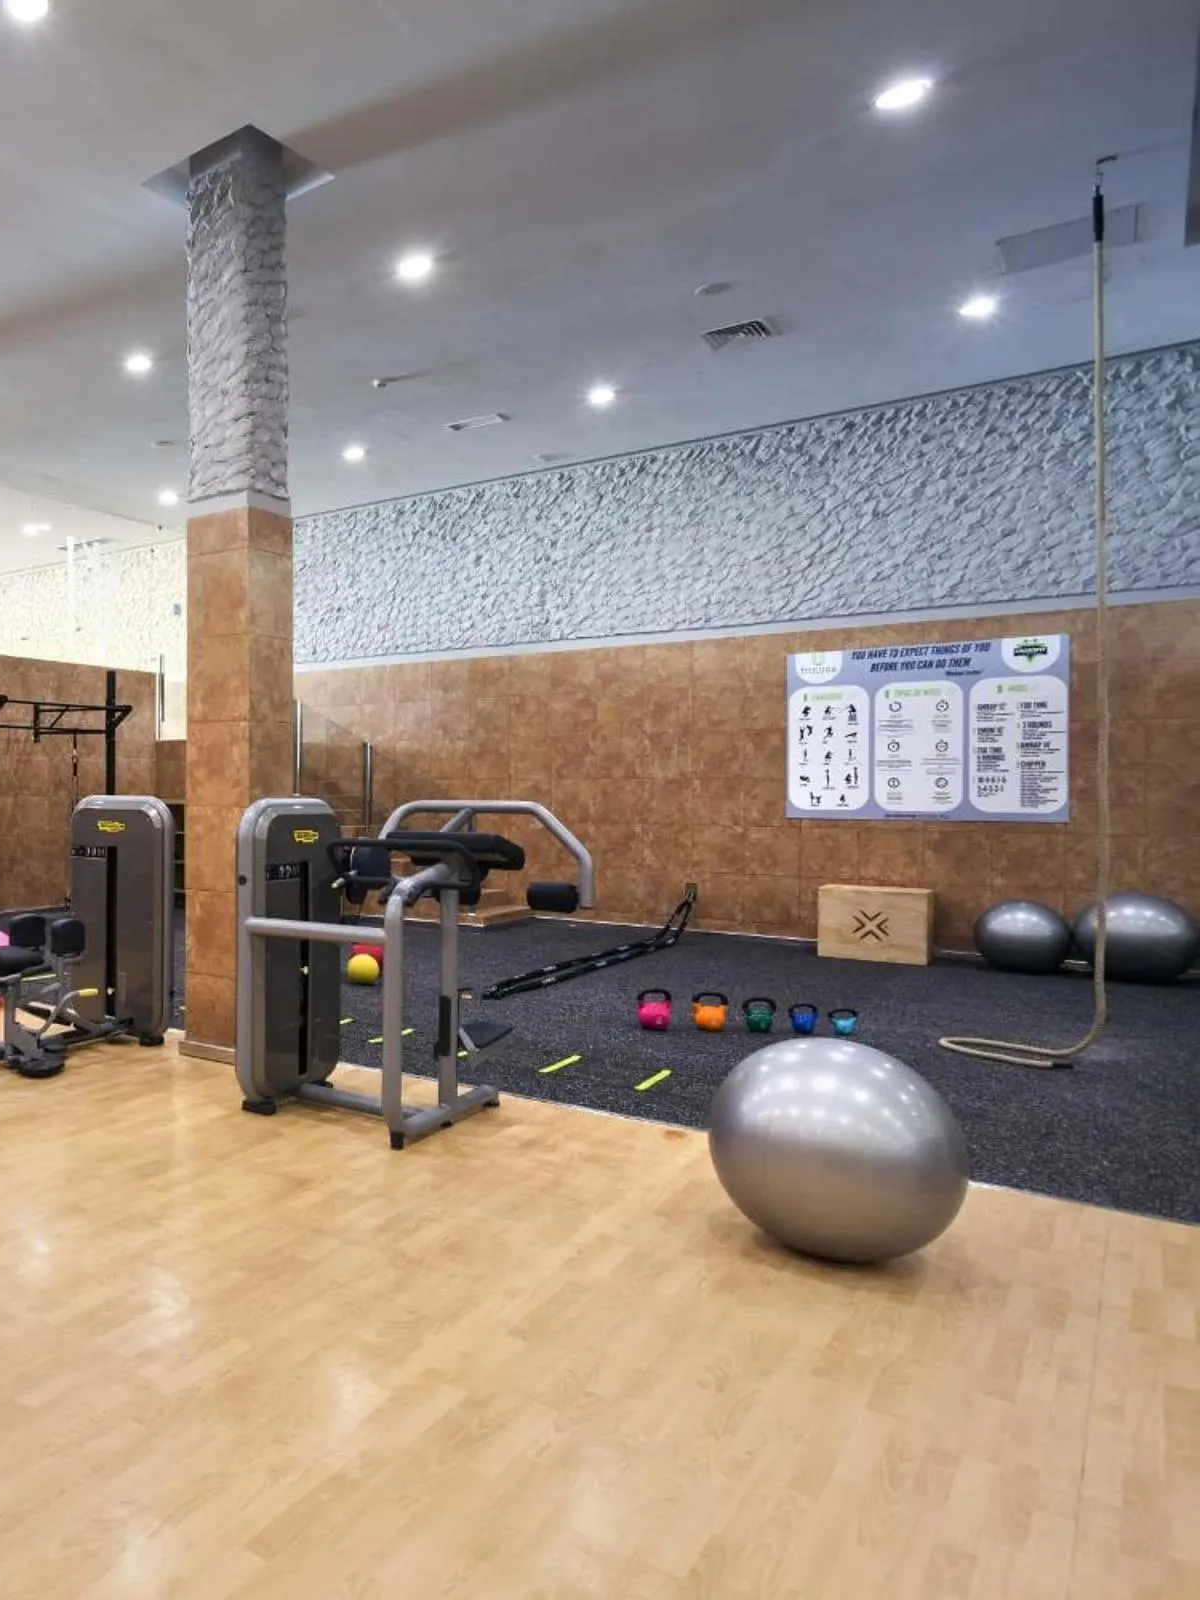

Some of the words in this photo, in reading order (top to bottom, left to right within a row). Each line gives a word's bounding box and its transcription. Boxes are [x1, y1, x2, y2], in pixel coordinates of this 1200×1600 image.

[851, 651, 866, 660] YOU
[866, 649, 888, 659] HAVE
[889, 648, 899, 658] TO
[899, 646, 929, 658] EXPECT
[930, 644, 961, 655] THINGS
[961, 643, 973, 654] OF
[974, 642, 992, 652] YOU
[870, 661, 899, 672] BEFORE
[899, 660, 916, 672] YOU
[917, 659, 934, 670] CAN
[935, 658, 946, 669] DO
[948, 657, 972, 668] THEM
